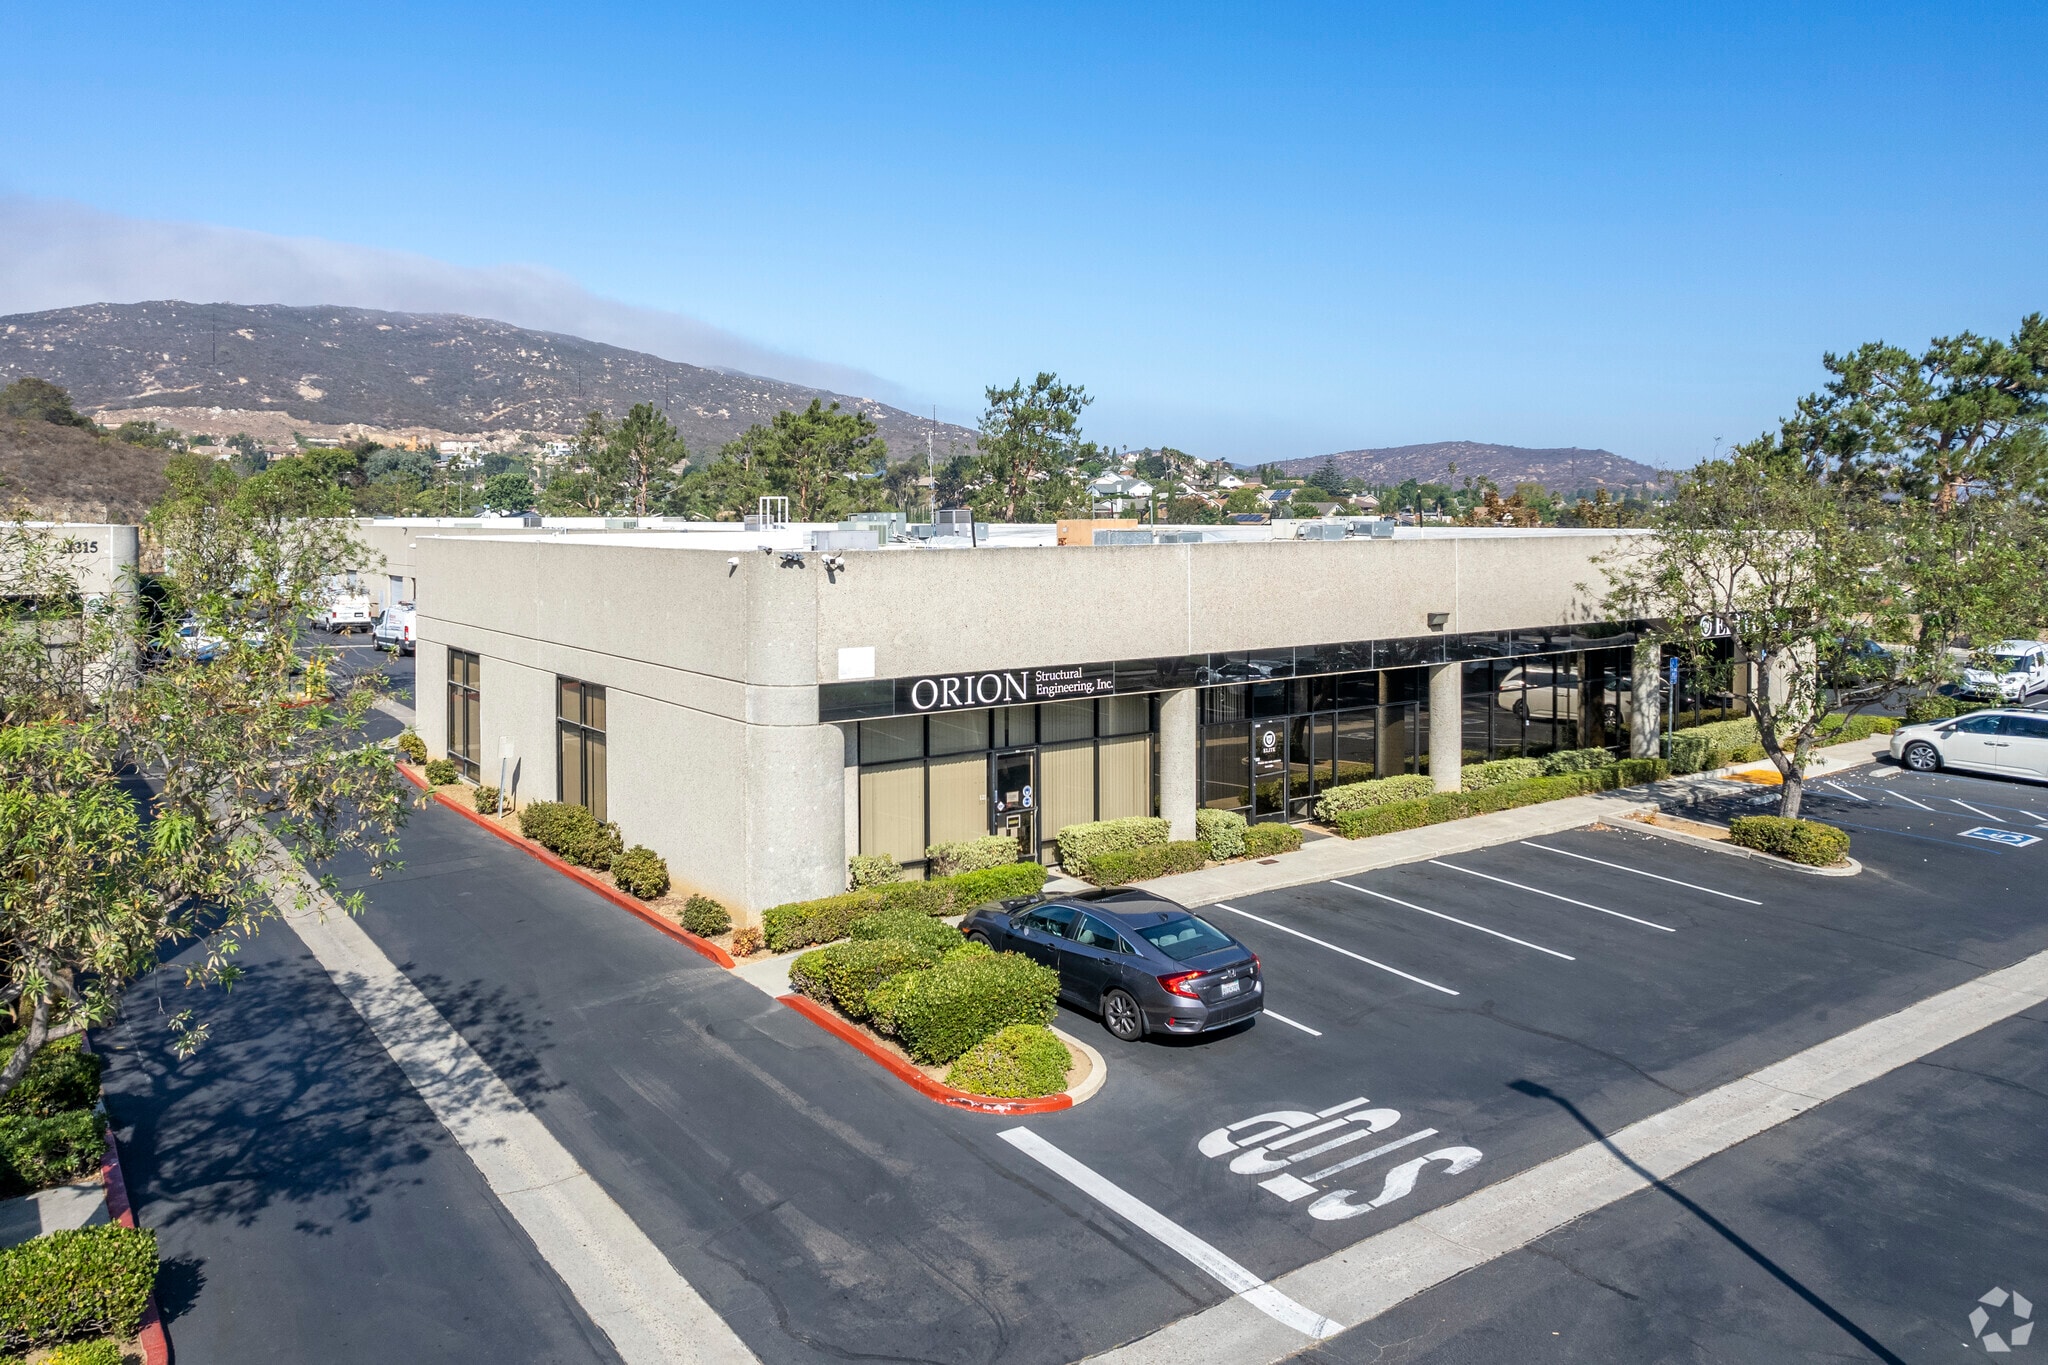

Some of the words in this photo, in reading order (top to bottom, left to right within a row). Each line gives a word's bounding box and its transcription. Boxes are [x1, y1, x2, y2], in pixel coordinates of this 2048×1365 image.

[1035, 667, 1083, 682] Structural
[1036, 680, 1095, 697] Engineering,
[1096, 678, 1114, 690] Inc.
[911, 671, 1030, 710] ORION
[1198, 1096, 1483, 1220] STOP
